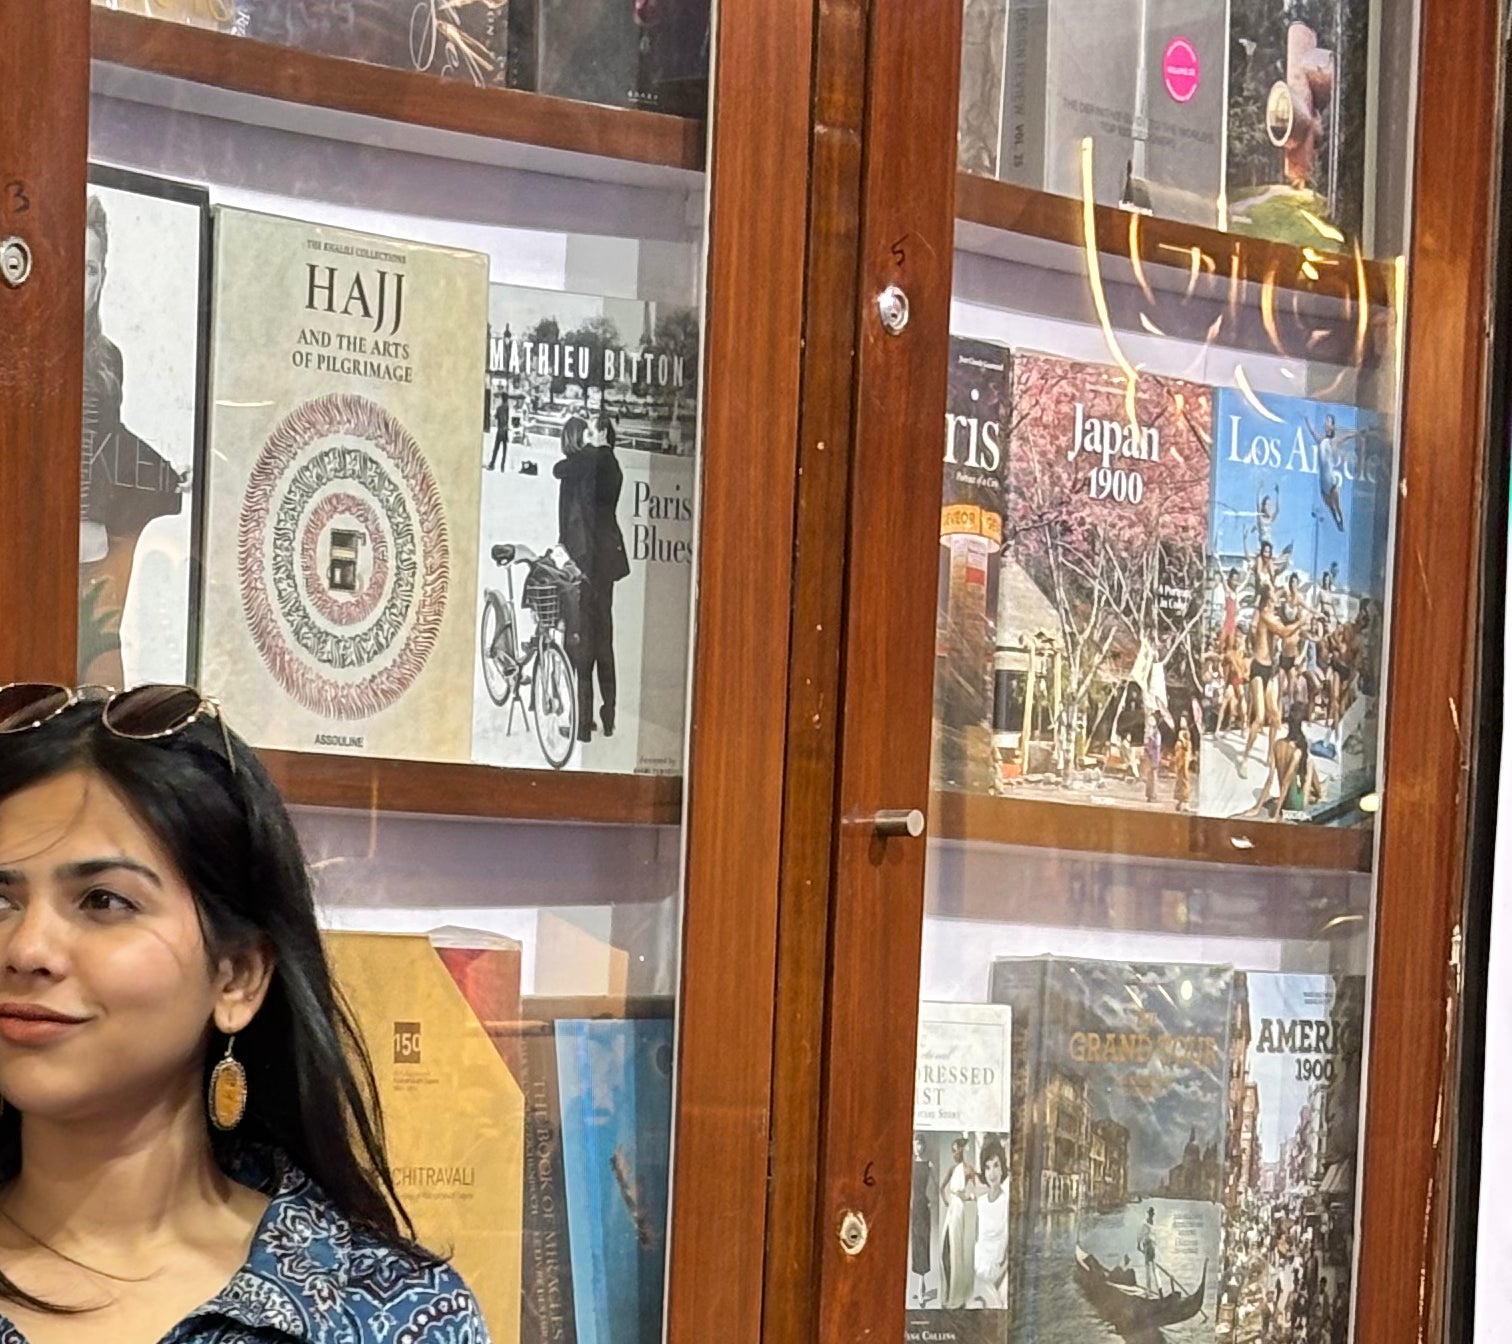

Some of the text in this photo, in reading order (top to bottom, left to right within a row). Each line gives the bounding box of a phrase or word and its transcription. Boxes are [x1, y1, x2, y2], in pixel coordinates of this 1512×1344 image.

[4, 181, 31, 214] 3
[304, 262, 406, 337] HAJJ
[296, 327, 411, 361] AND THE ARTS
[489, 338, 685, 388] MATHIEU BITTON
[291, 350, 414, 384] OF PILGRIMAGE
[942, 388, 1001, 472] ris
[1066, 402, 1161, 469] Japan
[1227, 414, 1282, 468] Los
[631, 480, 693, 521] Paris
[1086, 467, 1144, 504] 1900
[631, 523, 694, 565] Blues
[1069, 1031, 1153, 1063] GRAND
[918, 1065, 996, 1086] RESSED
[1294, 1058, 1335, 1082] 1900
[392, 1166, 476, 1187] CHITRAVALI
[537, 1128, 554, 1190] BOOK
